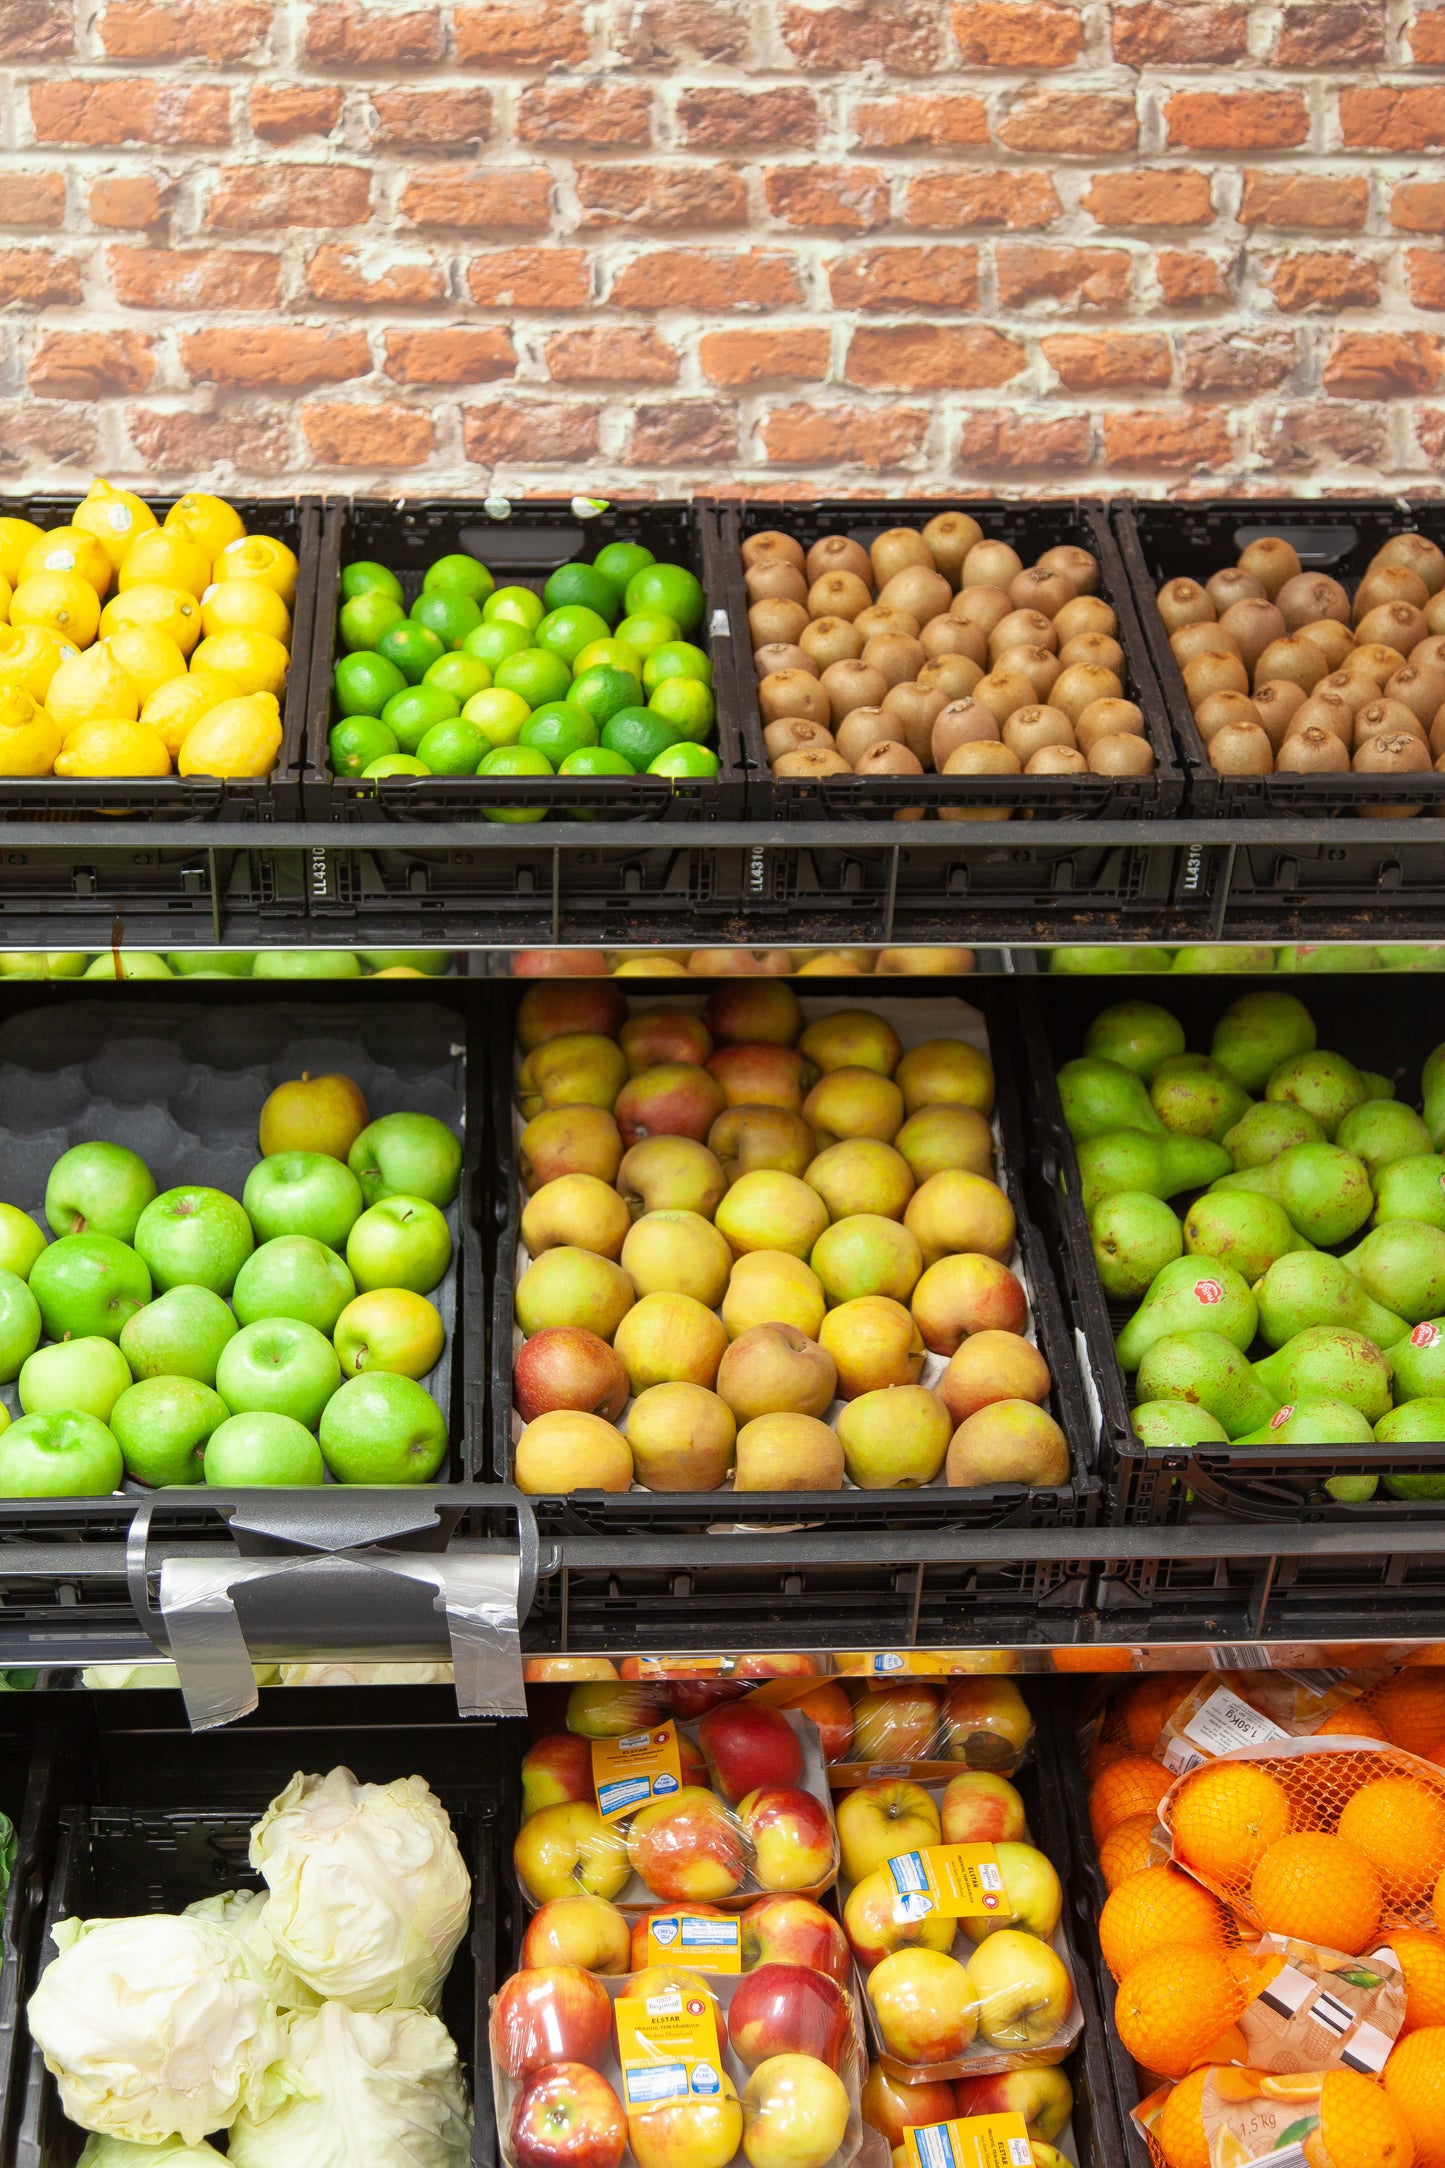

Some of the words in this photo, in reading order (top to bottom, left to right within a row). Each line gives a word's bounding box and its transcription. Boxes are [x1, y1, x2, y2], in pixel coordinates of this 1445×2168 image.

[312, 847, 327, 895] LL4310
[750, 845, 764, 892] LL4310
[1184, 844, 1203, 889] LL4310
[1225, 1709, 1258, 1738] 1,50Kg
[967, 1867, 978, 1888] ELSTAR
[983, 1865, 996, 1889] Regional
[651, 2016, 680, 2024] ELSTAR
[1240, 2117, 1259, 2136] 1,5
[1261, 2113, 1276, 2129] kg
[998, 2142, 1008, 2165] ELSTAR
[1013, 2139, 1026, 2163] Regional
